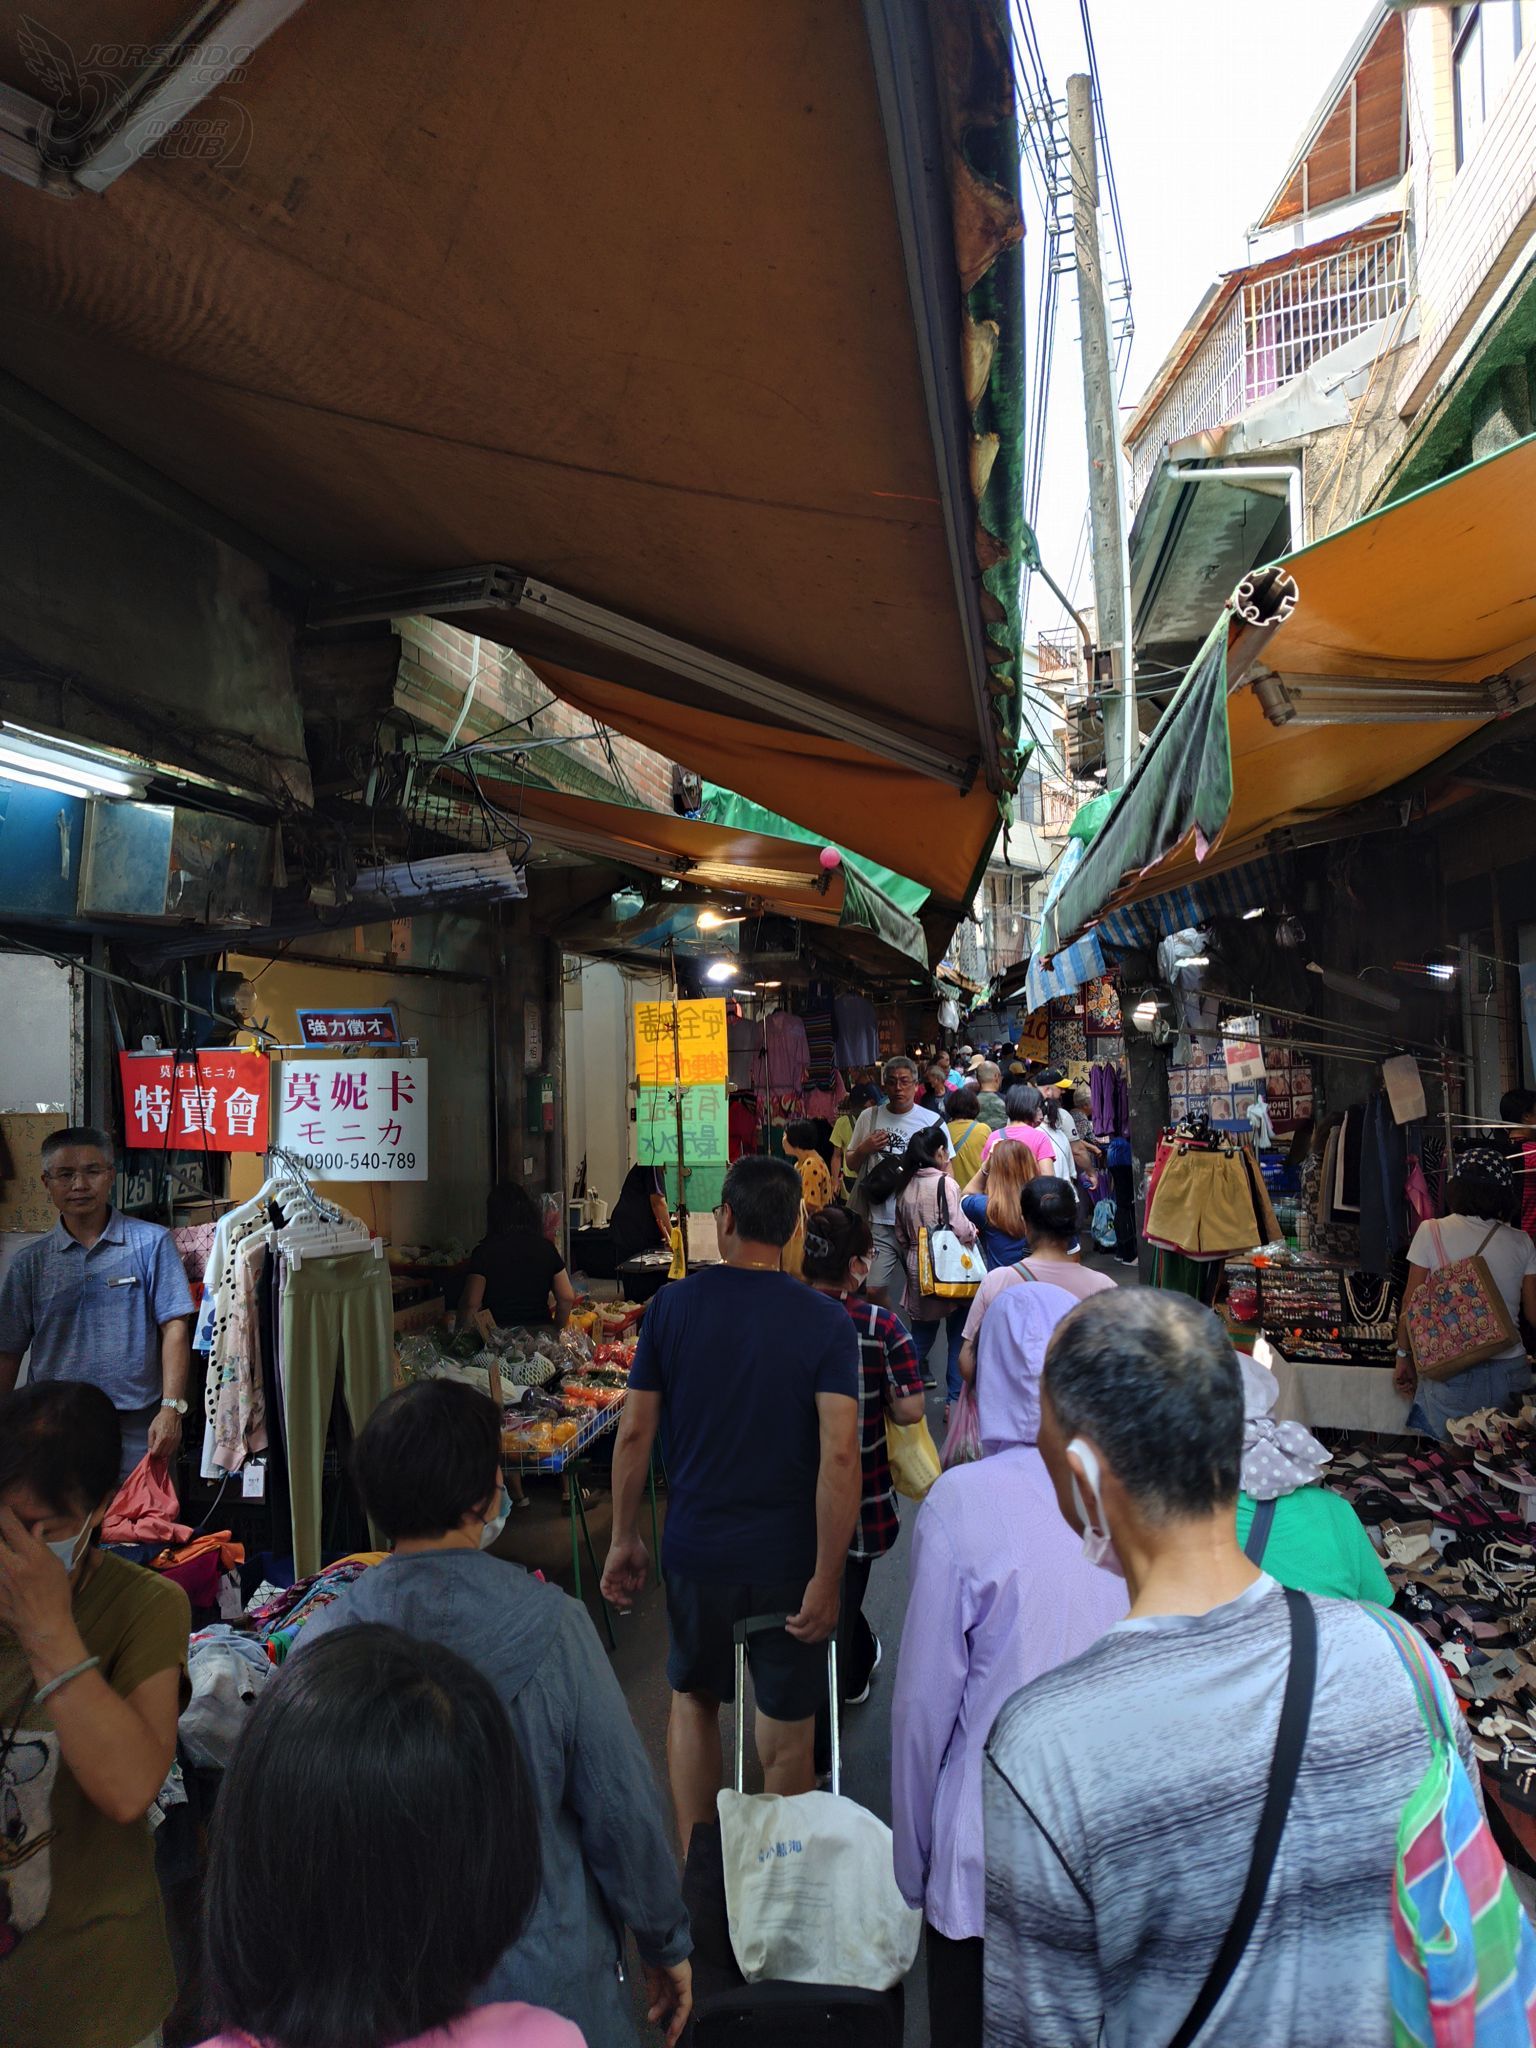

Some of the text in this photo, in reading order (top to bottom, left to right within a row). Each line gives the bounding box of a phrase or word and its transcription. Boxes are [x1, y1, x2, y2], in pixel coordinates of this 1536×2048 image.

[306, 1017, 383, 1037] 強力徵才
[202, 1066, 237, 1079] モニカ
[283, 1070, 416, 1113] 莫妮卡
[134, 1085, 260, 1136] 特賣會
[297, 1118, 402, 1146] モニカ
